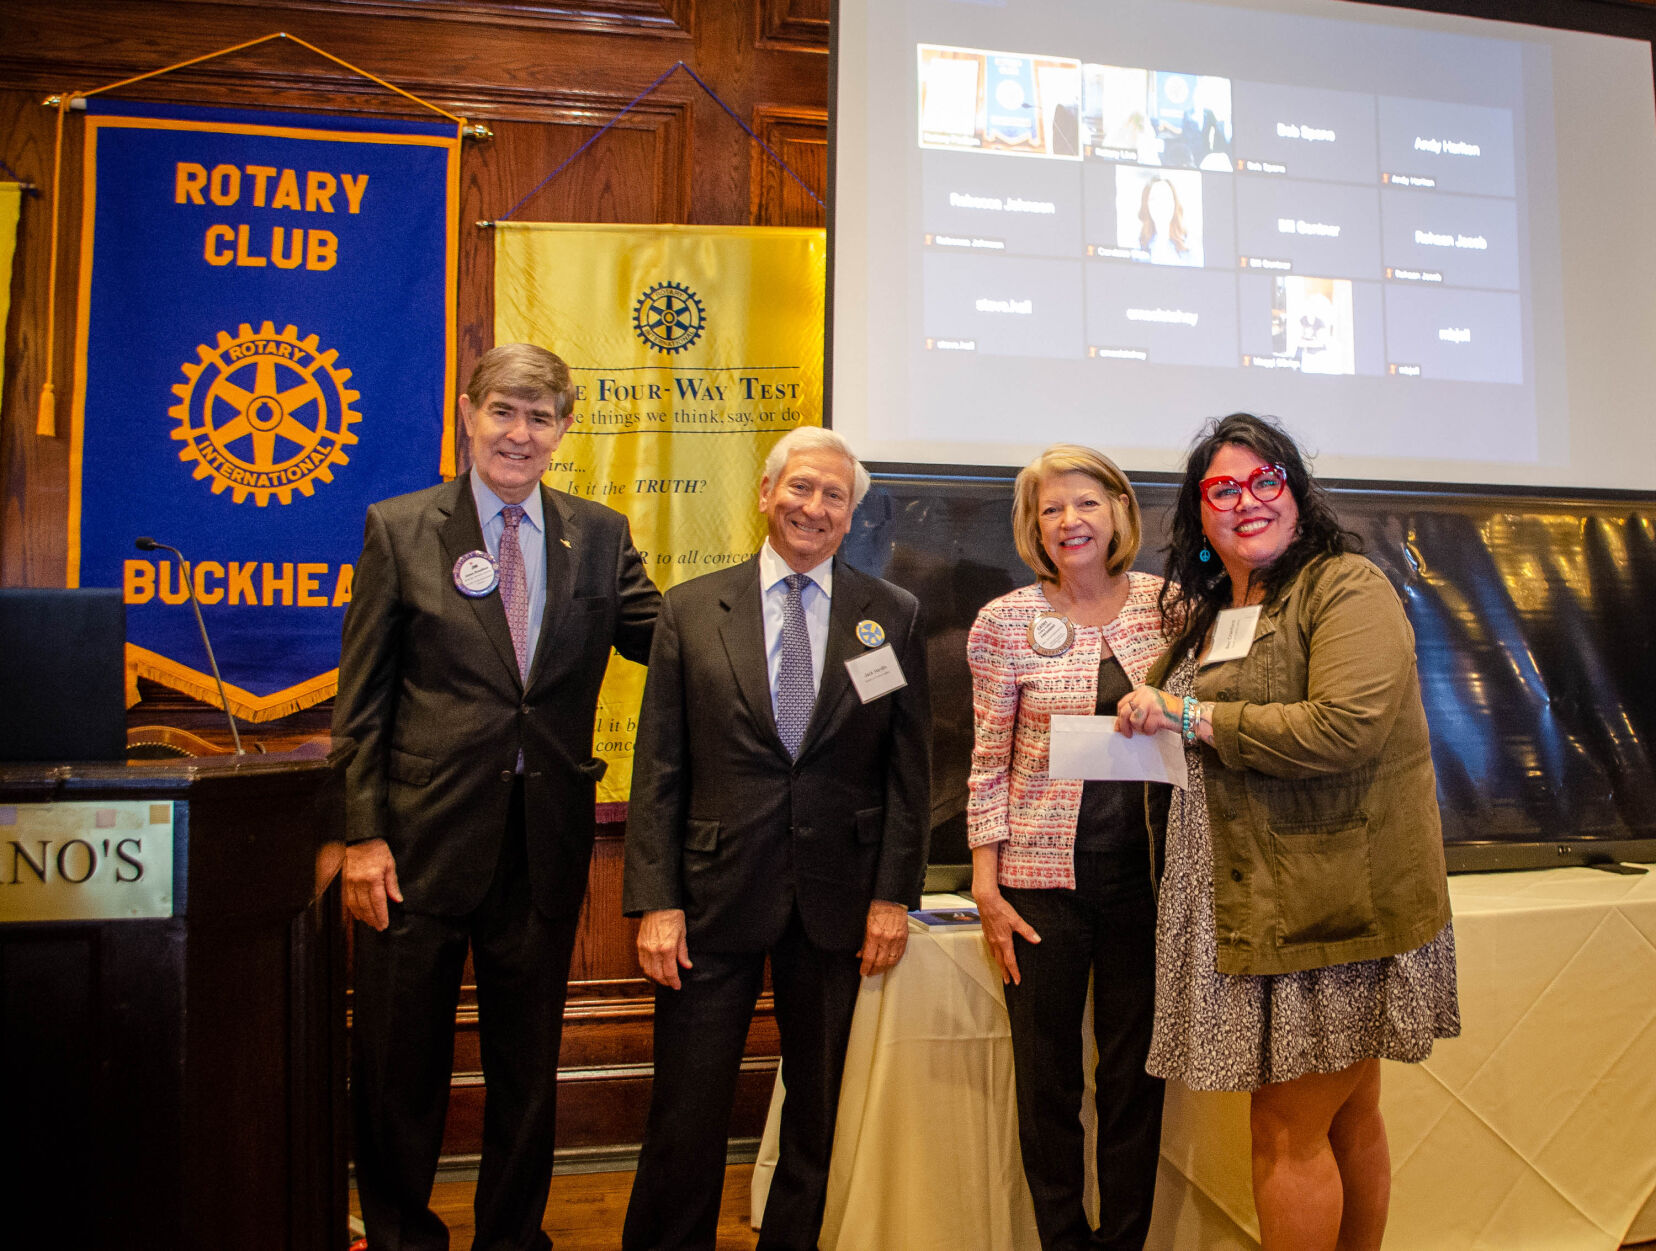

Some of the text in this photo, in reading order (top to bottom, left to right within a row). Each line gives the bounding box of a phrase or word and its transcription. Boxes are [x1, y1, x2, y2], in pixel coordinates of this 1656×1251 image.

[175, 162, 369, 214] ROTARY
[204, 224, 338, 271] CLUB
[655, 288, 685, 298] ROTARY
[228, 340, 306, 362] ROTARY
[740, 377, 800, 400] TEST
[591, 410, 641, 428] things
[646, 411, 667, 423] we
[674, 409, 724, 424] think,
[727, 411, 754, 426] say,
[759, 411, 776, 422] or
[781, 407, 801, 422] do
[199, 440, 331, 487] INTERNATIONAL
[548, 459, 586, 472] irst...
[568, 479, 707, 495] Is it the TRUTH?
[656, 553, 672, 565] to
[677, 550, 699, 564] all
[124, 559, 354, 607] BUCKHEA
[609, 718, 620, 732] it
[596, 741, 633, 752] conc
[0, 838, 145, 885] NO'S
